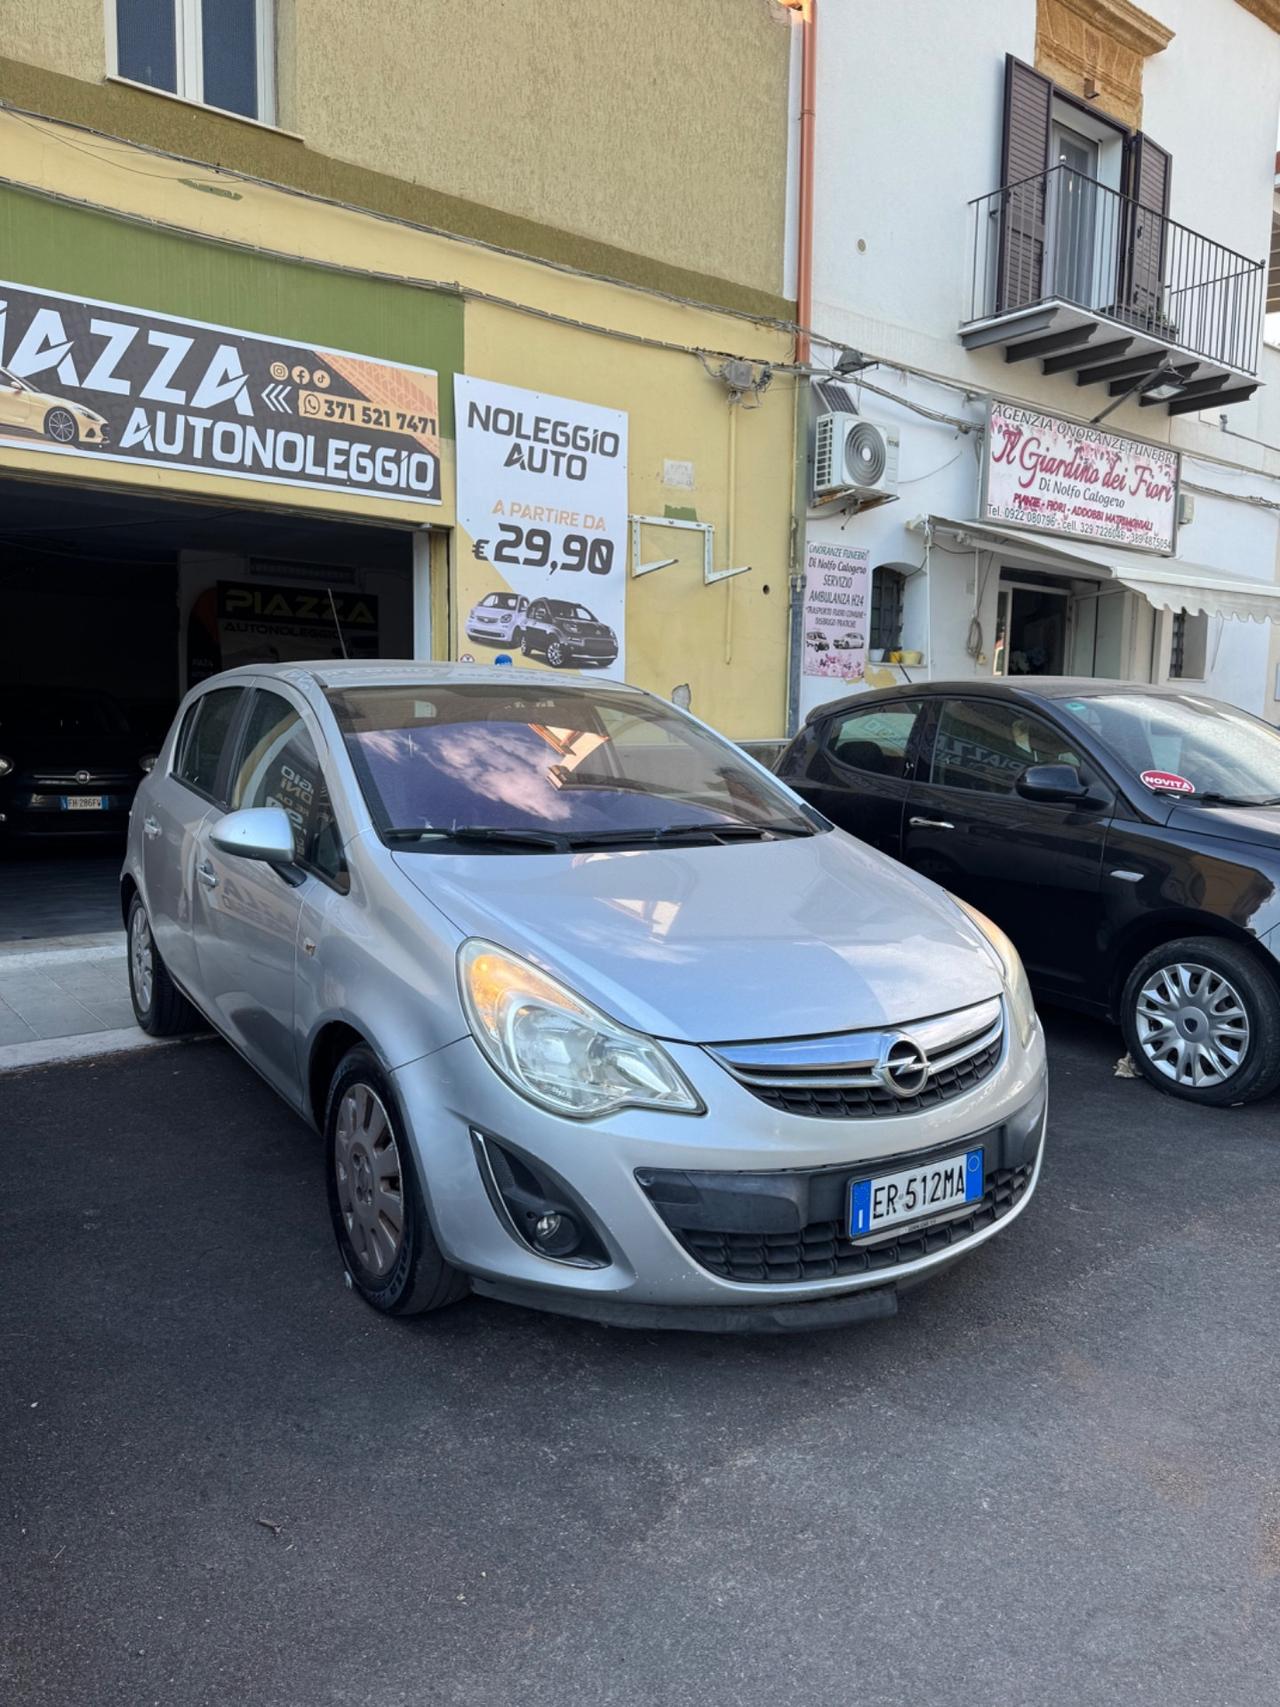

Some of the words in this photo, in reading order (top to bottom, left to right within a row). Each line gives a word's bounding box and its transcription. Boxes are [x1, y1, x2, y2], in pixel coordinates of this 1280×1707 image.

[324, 399, 356, 422] 371
[361, 404, 391, 428] 521
[395, 410, 437, 436] 7471
[467, 401, 620, 458] NOLEGGIO
[991, 404, 1053, 431] AGENZIA
[1057, 422, 1126, 452] ONORANZE
[118, 406, 435, 491] AUTONOLEGGIO
[503, 442, 587, 482] AUTO
[992, 429, 1023, 465] Il
[1019, 437, 1099, 488] Giardino
[1102, 453, 1127, 491] dei
[1129, 465, 1173, 502] Fiori
[1039, 477, 1051, 492] Di
[1053, 481, 1081, 498] Nolfo
[1083, 488, 1126, 508] Calogero
[491, 499, 505, 516] A
[510, 502, 580, 525] PARTIRE
[583, 514, 607, 532] DA
[987, 504, 1002, 517] Tel.
[1004, 508, 1025, 521] 0922
[1046, 500, 1067, 513] FIORI
[1071, 506, 1104, 521] ADDOBBI
[1105, 513, 1154, 531] MATRIMONIALI
[493, 523, 614, 575] 29,90
[823, 574, 852, 588] SERVIZIO
[838, 561, 867, 575] Calogero
[809, 589, 850, 605] AMBULANZA
[872, 1183, 899, 1220] ER
[904, 1164, 965, 1211] 512MA
